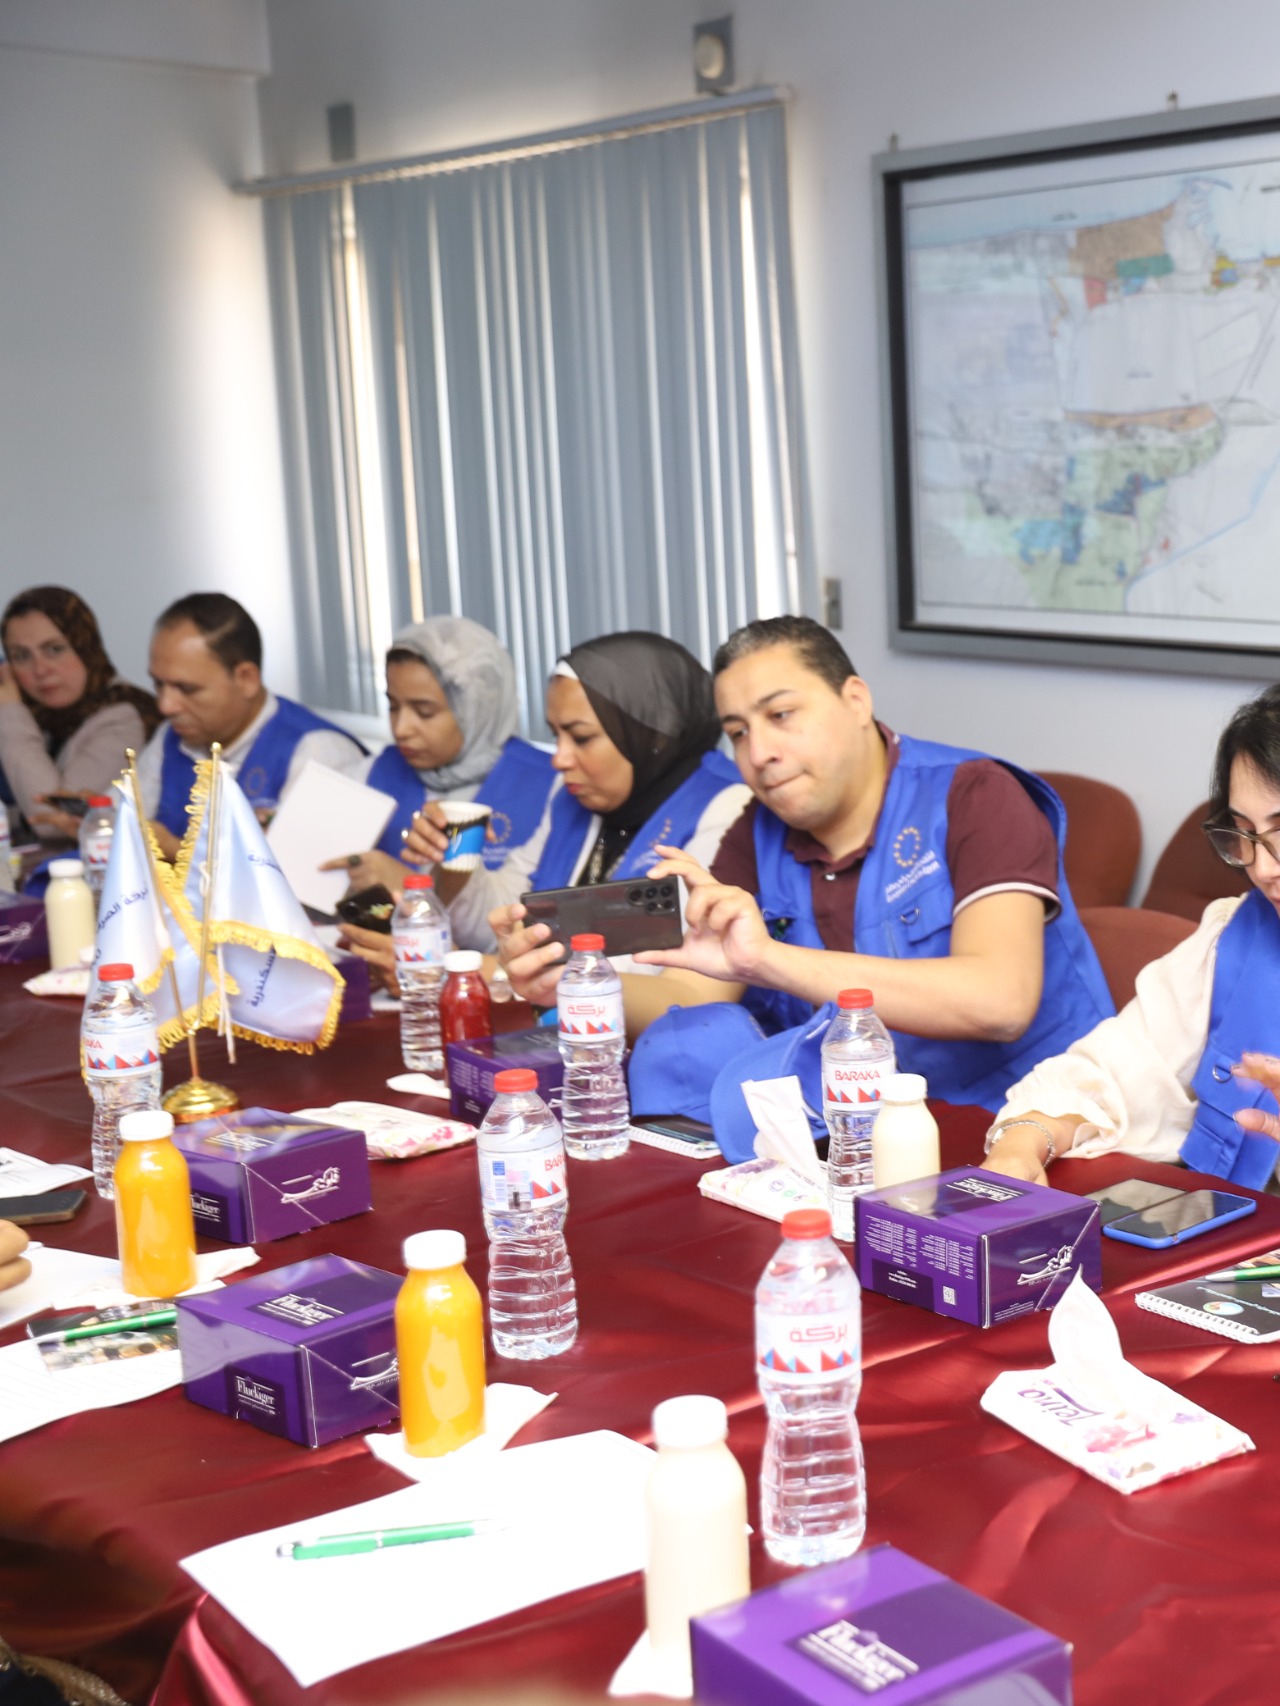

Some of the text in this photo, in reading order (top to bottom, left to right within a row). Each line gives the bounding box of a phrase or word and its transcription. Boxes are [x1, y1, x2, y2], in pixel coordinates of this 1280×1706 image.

[567, 1003, 606, 1018] بركة
[834, 1069, 881, 1082] BARAKA
[191, 1195, 219, 1216] luckiger
[790, 1323, 848, 1344] بركة
[236, 1379, 275, 1406] Fluckiger
